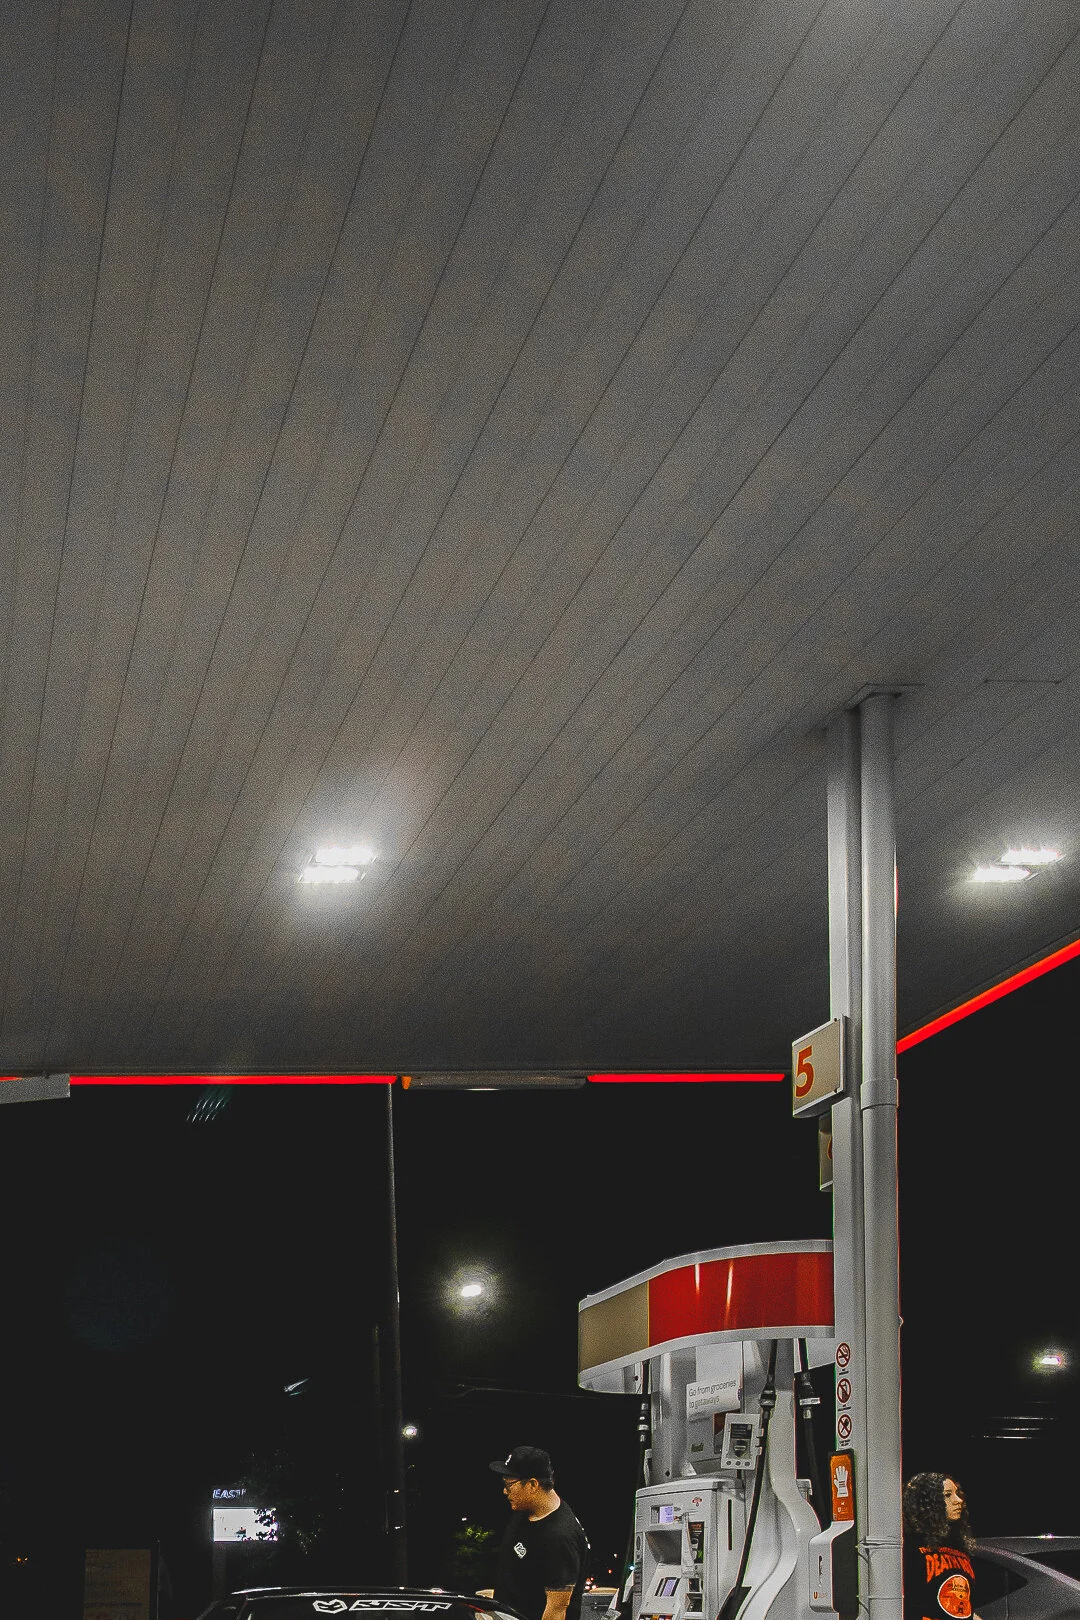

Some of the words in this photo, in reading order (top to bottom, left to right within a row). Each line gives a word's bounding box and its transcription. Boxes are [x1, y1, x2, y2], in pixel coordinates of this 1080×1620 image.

[795, 1045, 815, 1098] 5
[689, 1388, 696, 1397] Go
[697, 1385, 711, 1395] from
[711, 1379, 737, 1394] groceries
[689, 1401, 695, 1409] to
[926, 1553, 960, 1583] DEATH
